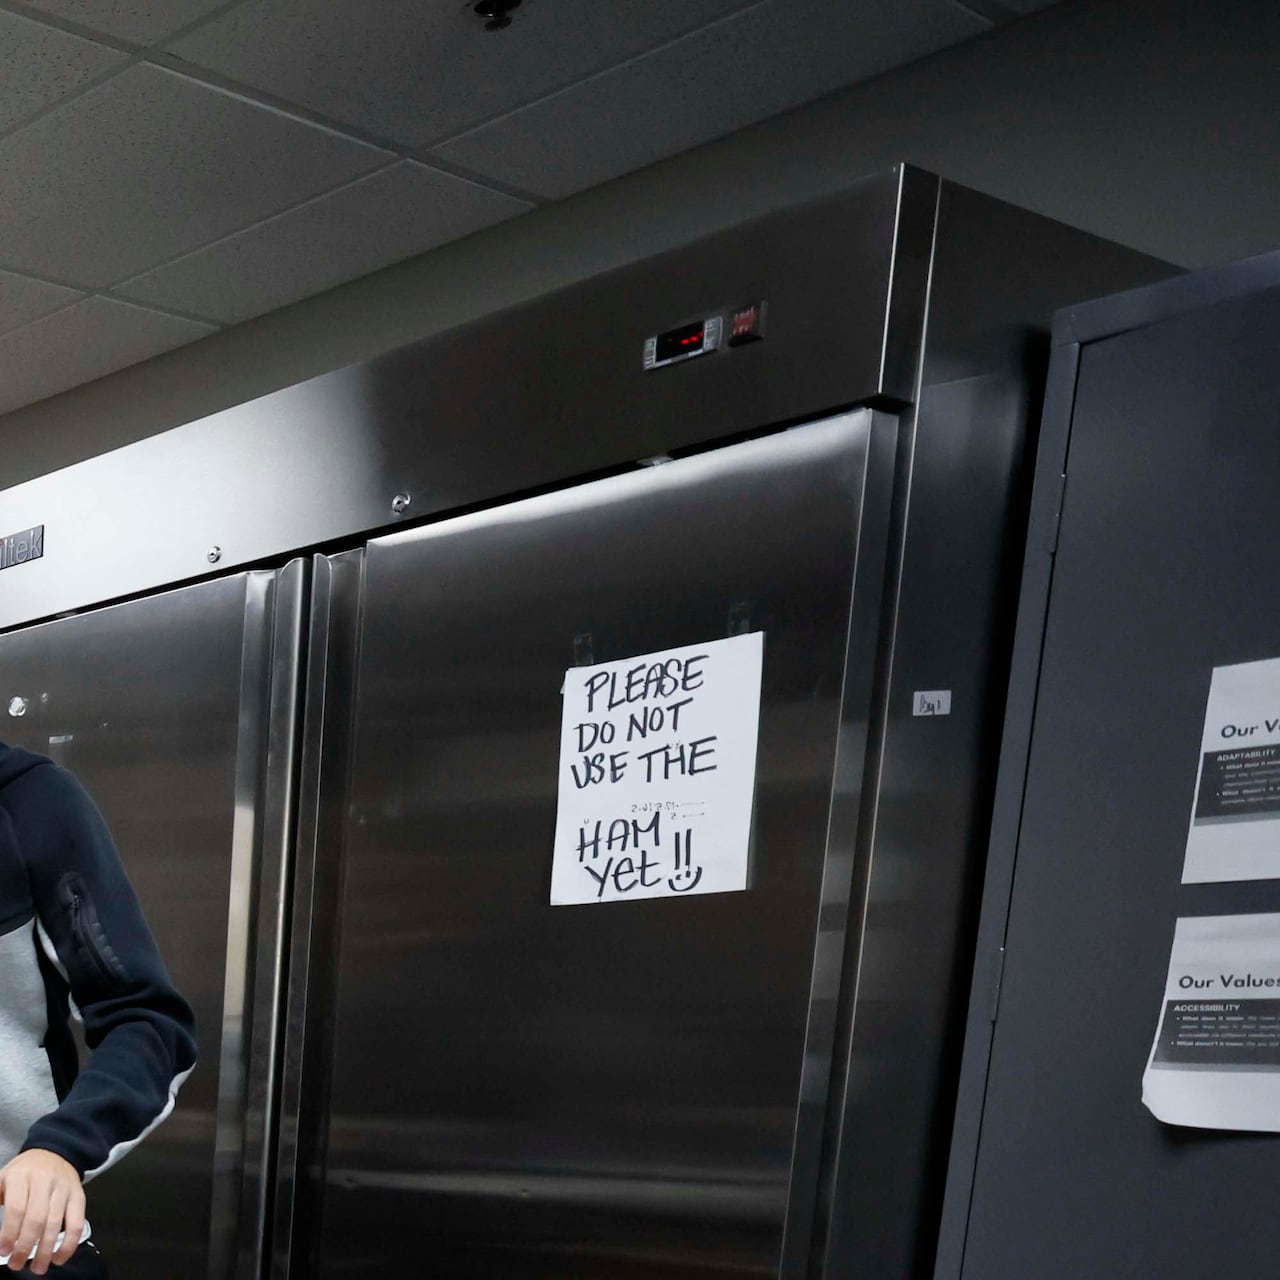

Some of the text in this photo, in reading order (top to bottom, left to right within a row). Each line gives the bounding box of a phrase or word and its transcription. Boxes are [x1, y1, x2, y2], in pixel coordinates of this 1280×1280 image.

[584, 655, 710, 712] PLEASE
[573, 697, 694, 753] DO NOT
[1221, 724, 1260, 739] Our
[571, 736, 718, 789] USE THE
[1217, 750, 1276, 761] ADAPTABILITY
[576, 811, 661, 862] HAM
[1178, 975, 1214, 989] Our
